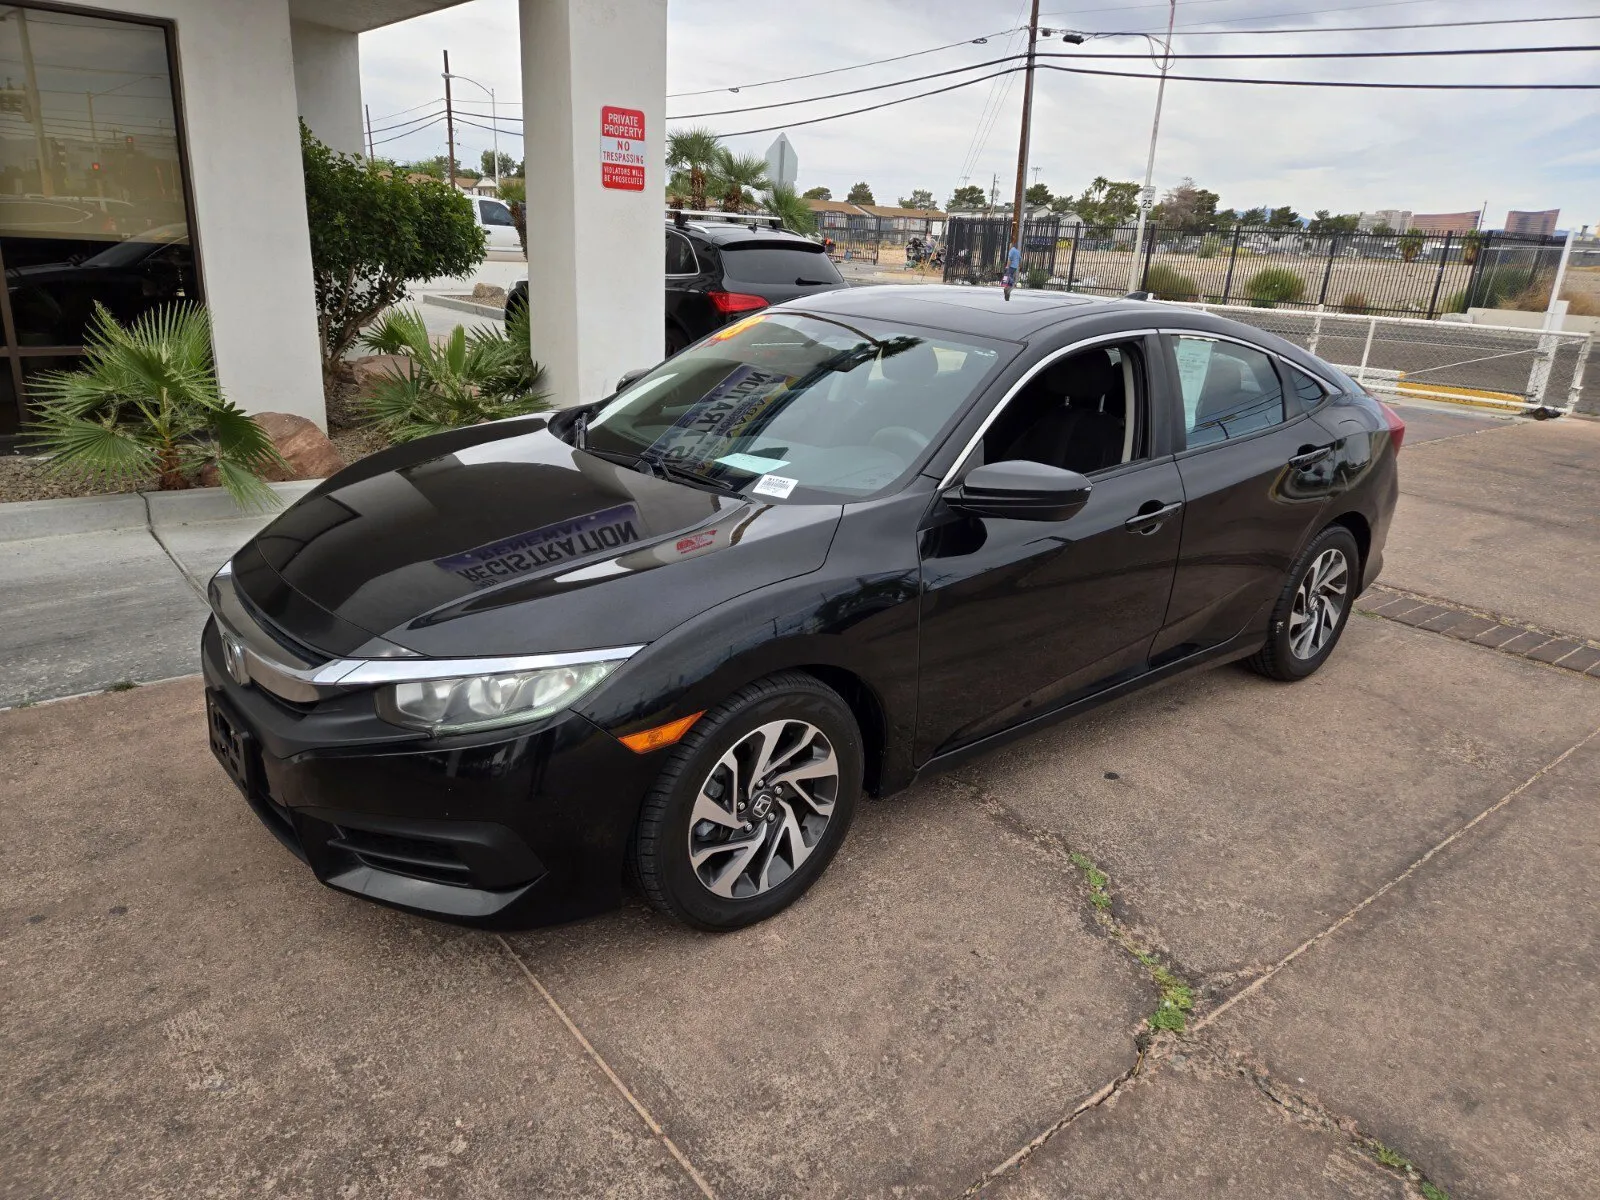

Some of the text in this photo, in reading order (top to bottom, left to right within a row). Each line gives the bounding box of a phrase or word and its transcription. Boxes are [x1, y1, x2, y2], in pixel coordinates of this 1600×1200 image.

[608, 113, 638, 127] PRIVATE
[604, 124, 642, 138] PROPERTY
[617, 140, 630, 151] NO
[603, 151, 644, 164] TRESPASSING
[604, 166, 643, 177] VIOLATORS WILL
[604, 174, 643, 185] BE PROSECUTED
[1142, 200, 1152, 208] 25
